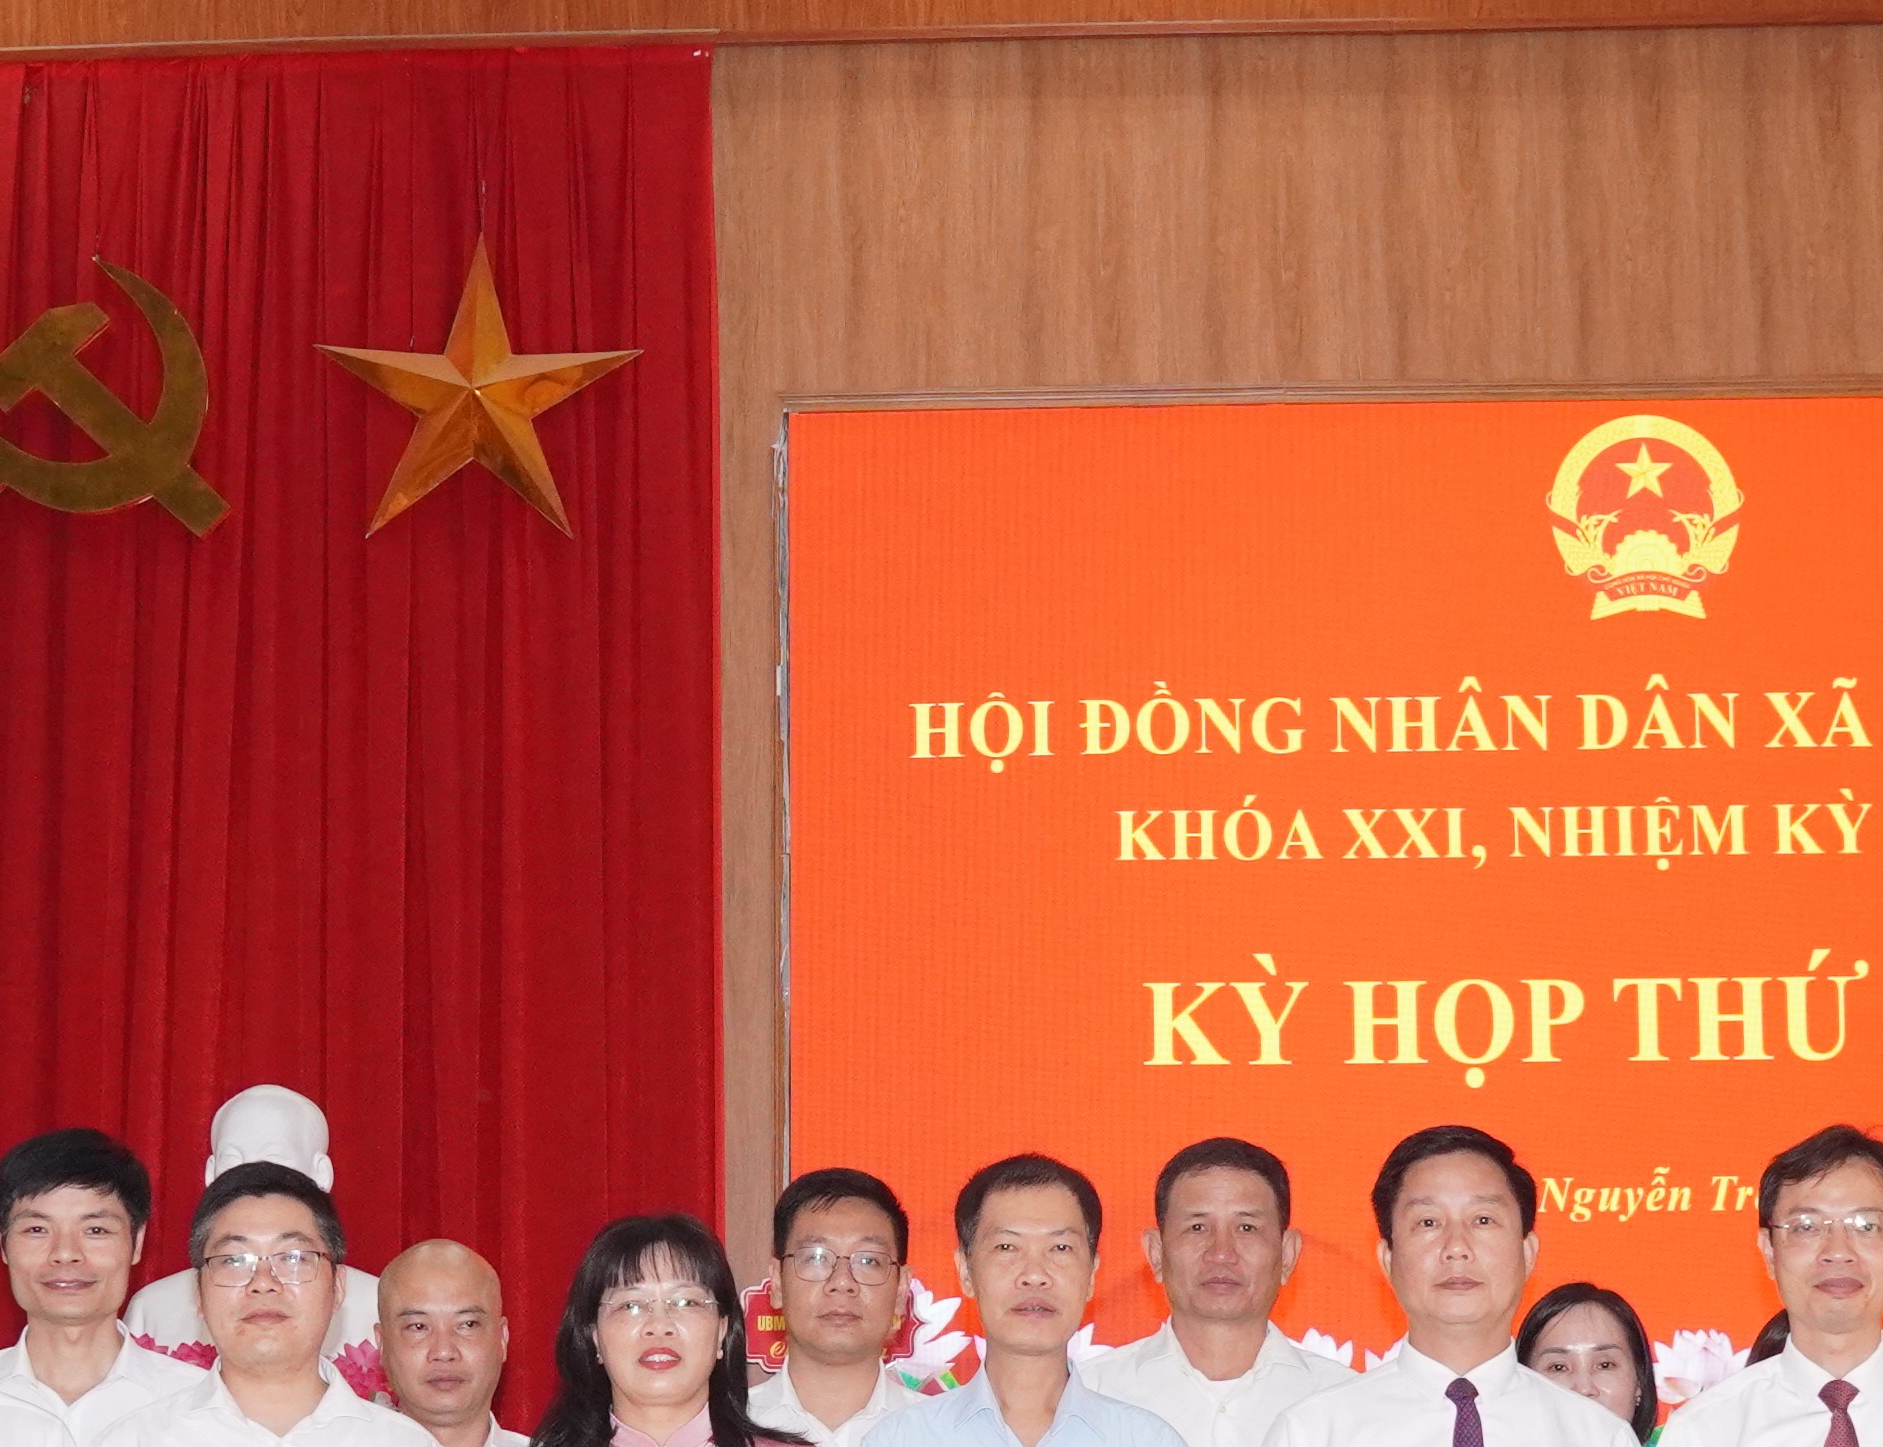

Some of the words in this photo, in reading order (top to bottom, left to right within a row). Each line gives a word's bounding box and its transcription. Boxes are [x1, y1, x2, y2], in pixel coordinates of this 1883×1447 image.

[909, 691, 1055, 774] HỘI
[1078, 680, 1305, 755] ĐỒNG
[1329, 675, 1552, 753] NHÂN
[1576, 673, 1740, 750] DÂN
[1764, 676, 1873, 748] XÃ
[1115, 794, 1324, 861] KHÓA
[1341, 807, 1487, 870] XXI,
[1508, 796, 1749, 871] NHIỆM
[1773, 787, 1873, 855] KỲ
[1142, 953, 1310, 1066] KỲ
[1342, 978, 1585, 1089] HỌP
[1612, 948, 1870, 1062] THỨ
[1537, 1166, 1692, 1223] Nguyễn
[1711, 1175, 1759, 1212] Tr
[757, 1315, 786, 1332] UBM
